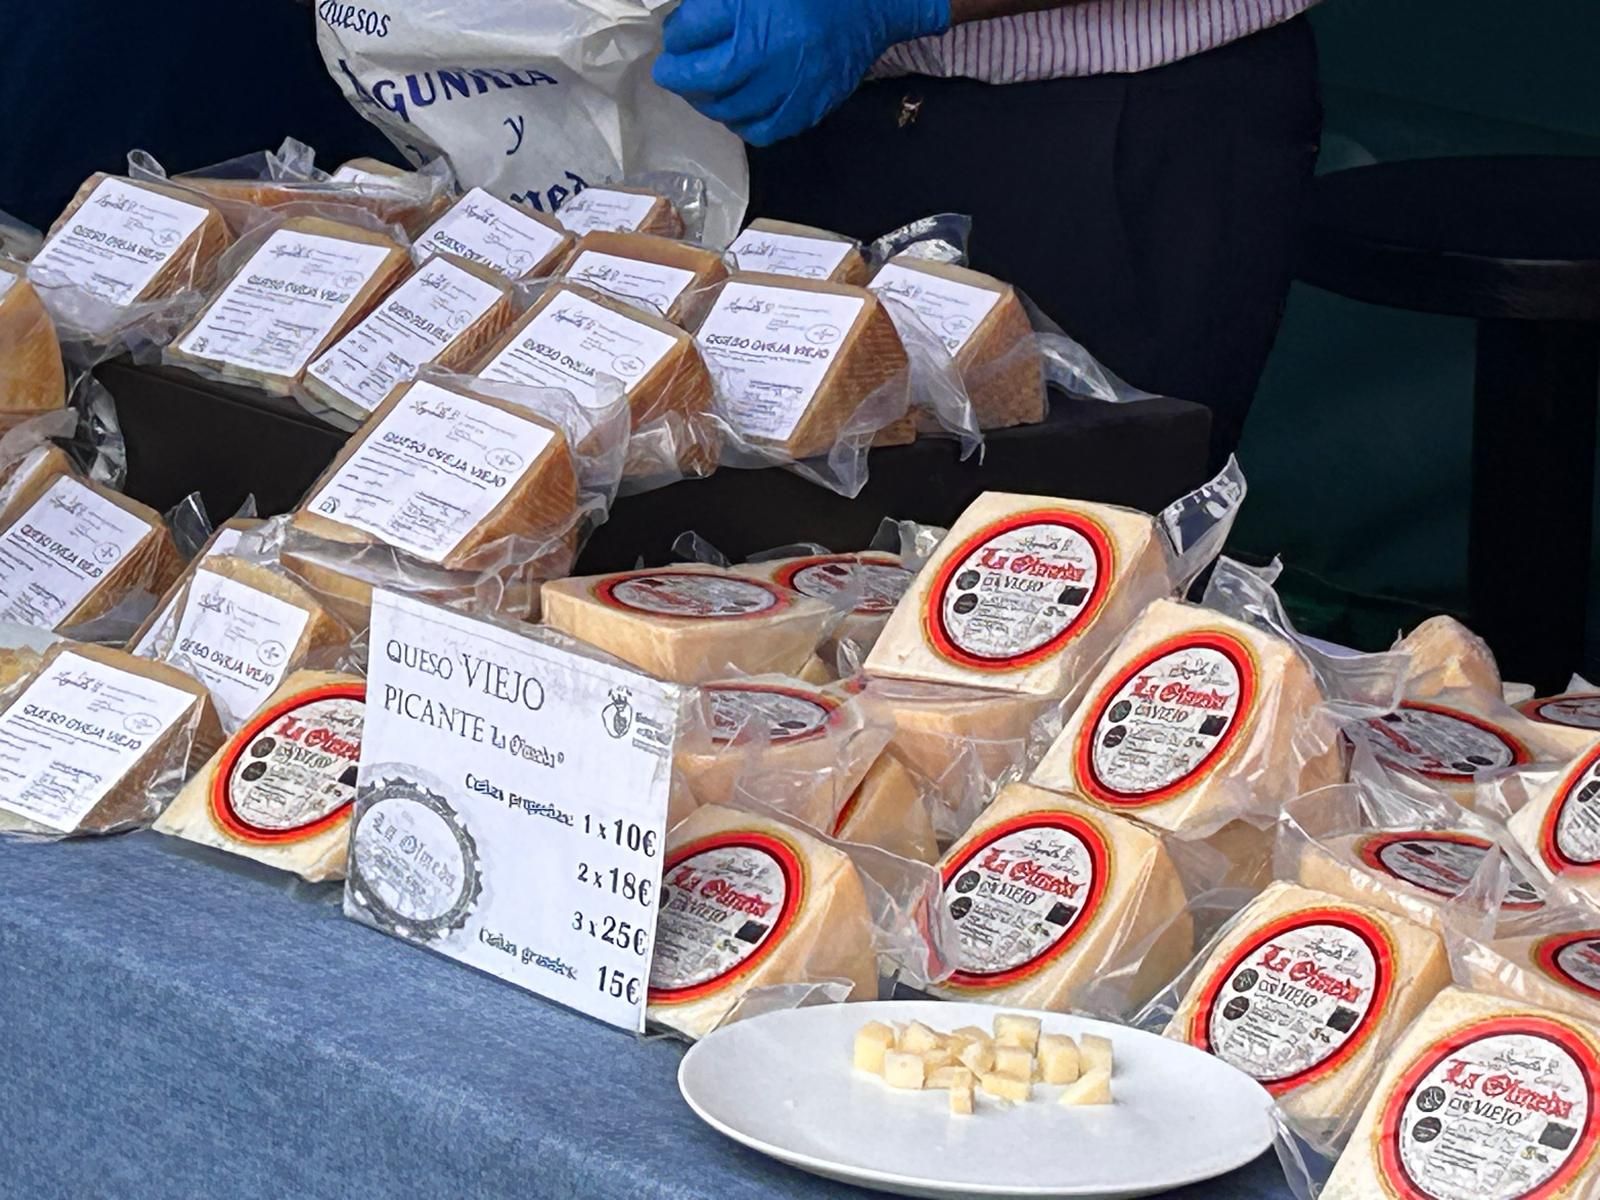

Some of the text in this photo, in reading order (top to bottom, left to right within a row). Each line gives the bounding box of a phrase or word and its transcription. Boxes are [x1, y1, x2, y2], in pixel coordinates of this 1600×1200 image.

[503, 115, 524, 155] y
[426, 446, 468, 471] OVEJA
[469, 464, 507, 488] VIEJO
[386, 638, 545, 711] QUESO VIEJO
[384, 683, 485, 744] PICANTE
[584, 814, 591, 834] 1
[598, 823, 607, 839] x
[613, 818, 657, 858] 10€
[577, 862, 652, 907] 2 x 18€
[571, 911, 647, 956] 3 x 25€
[598, 965, 641, 1005] 15€
[1472, 1099, 1522, 1127] VIEJO
